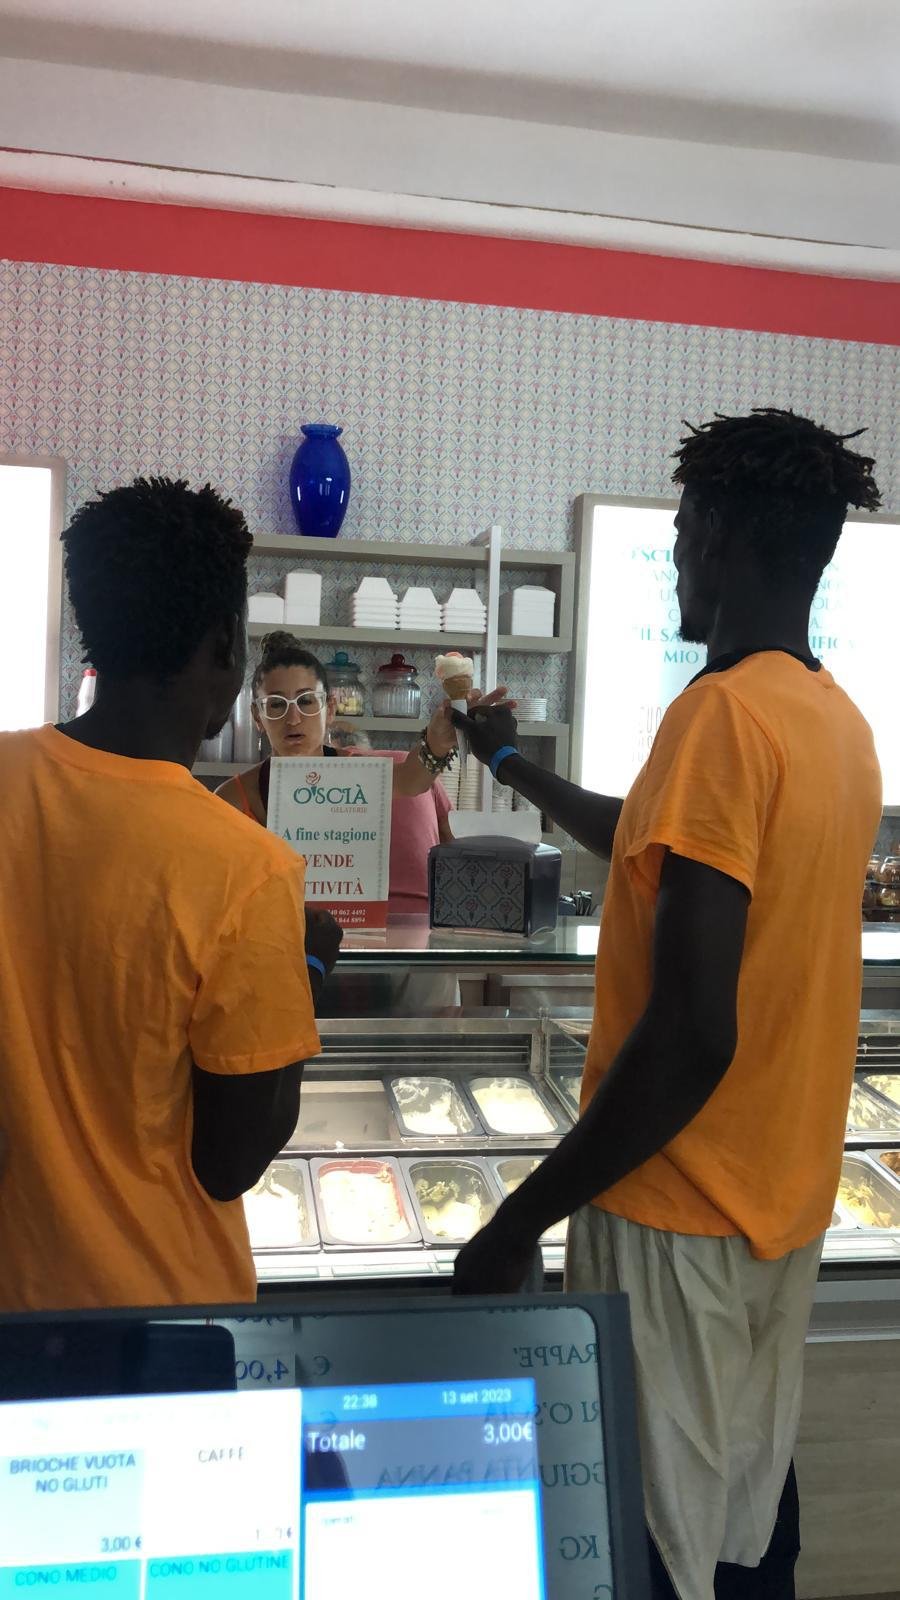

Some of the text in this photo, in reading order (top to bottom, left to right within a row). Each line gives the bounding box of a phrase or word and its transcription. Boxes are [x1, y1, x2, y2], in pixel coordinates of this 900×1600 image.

[663, 650, 700, 665] MIO
[282, 827, 377, 844] A fine stagione
[302, 854, 354, 868] VENDE
[442, 1388, 512, 1406] 13 set 2023
[307, 1421, 533, 1452] Totale 3,00€
[10, 1452, 136, 1475] BRIOCHE VUOTA
[35, 1475, 107, 1493] NO GLUTI
[100, 1536, 131, 1553] 3,00
[150, 1554, 289, 1577] CONO NO GLUTINE
[15, 1565, 117, 1587] CONO MEDIO
